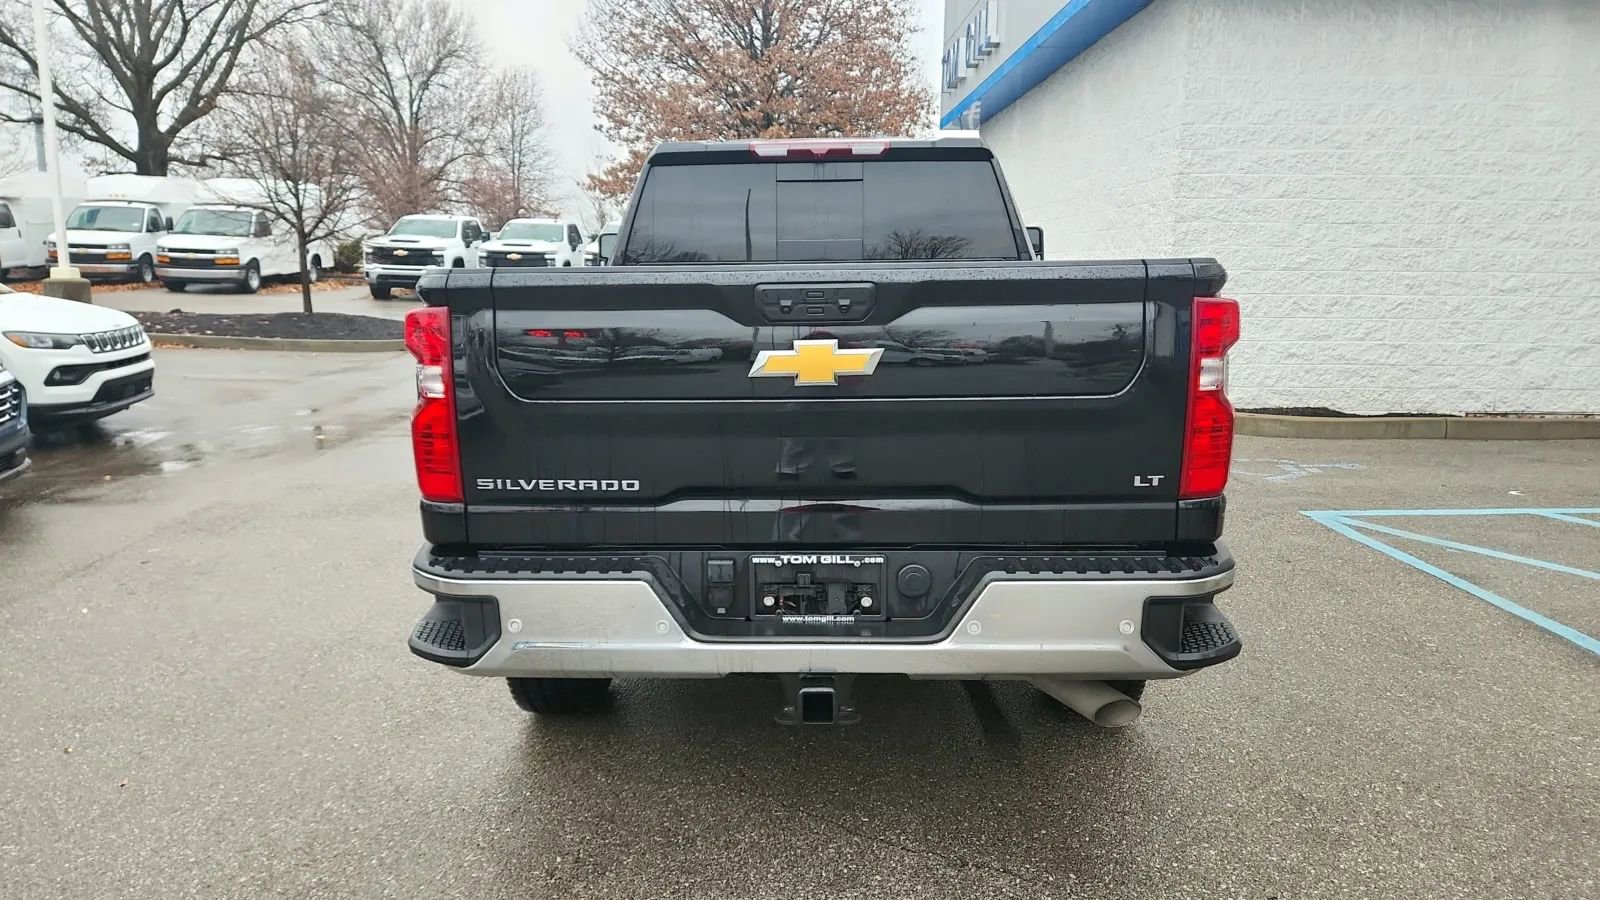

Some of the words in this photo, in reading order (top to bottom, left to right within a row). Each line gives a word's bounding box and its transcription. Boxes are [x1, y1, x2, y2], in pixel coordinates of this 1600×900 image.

[476, 478, 640, 493] SILVERADO
[1133, 475, 1165, 487] LT
[782, 615, 855, 623] www.tomgill.com
